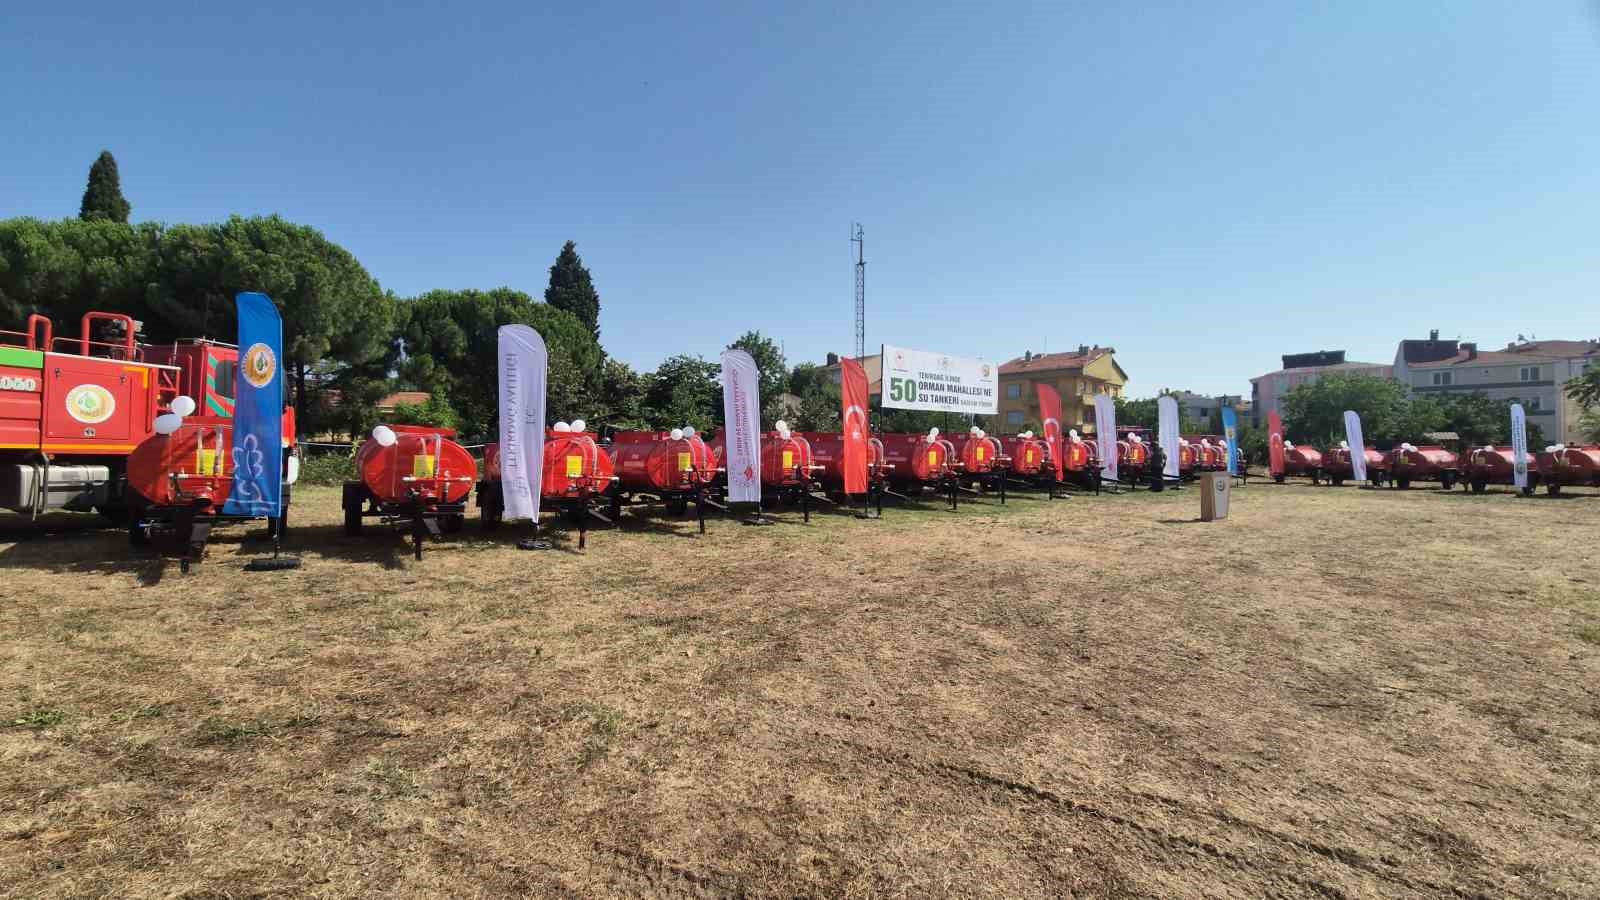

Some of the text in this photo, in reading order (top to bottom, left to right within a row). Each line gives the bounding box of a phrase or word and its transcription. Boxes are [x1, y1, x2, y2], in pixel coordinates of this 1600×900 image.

[890, 377, 917, 402] 50
[918, 381, 945, 391] ORMAN
[918, 393, 929, 403] SU
